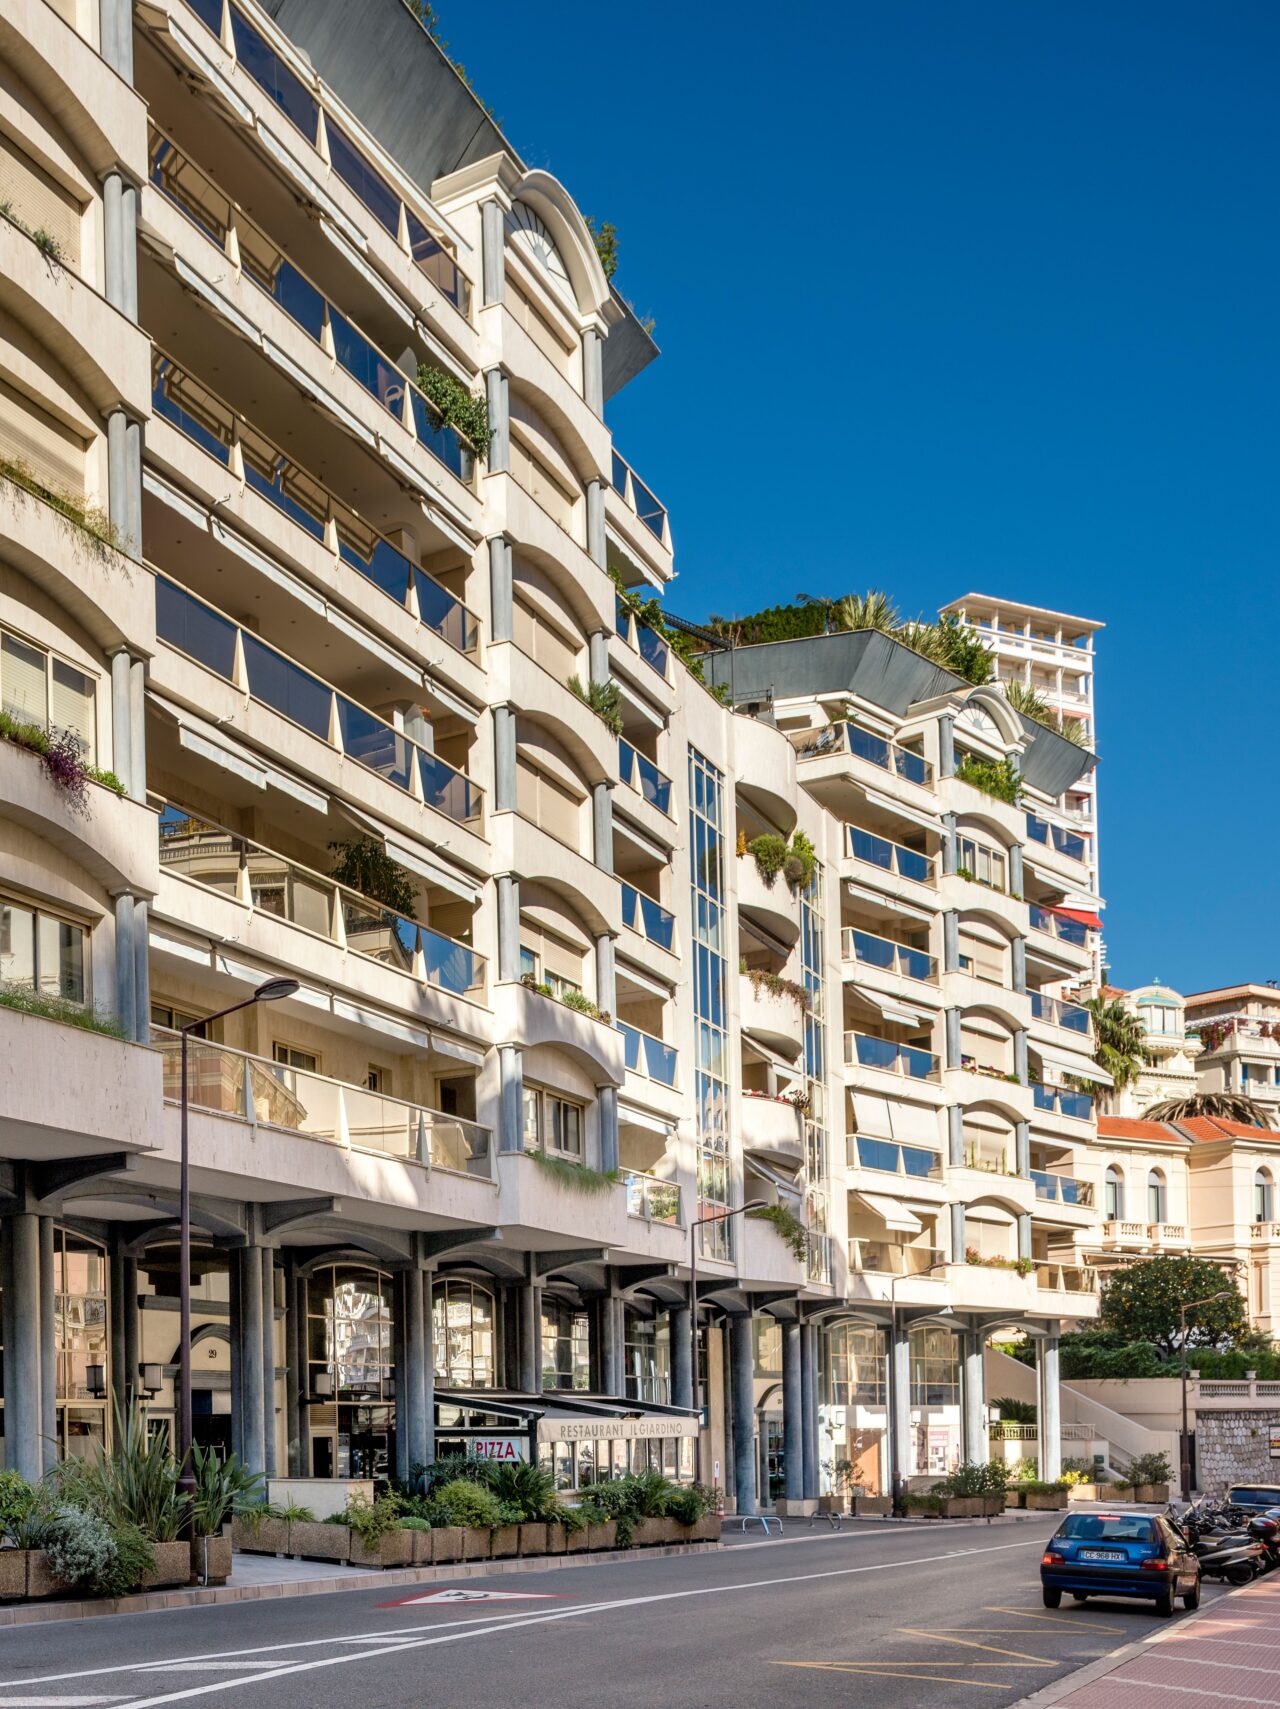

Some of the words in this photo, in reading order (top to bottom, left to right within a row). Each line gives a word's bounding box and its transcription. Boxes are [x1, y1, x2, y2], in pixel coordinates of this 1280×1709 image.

[208, 1349, 217, 1358] 29
[560, 1424, 624, 1438] RESTAURANT
[630, 1424, 638, 1436] IL
[640, 1423, 683, 1435] GIARDINO
[476, 1441, 516, 1458] PIZZA
